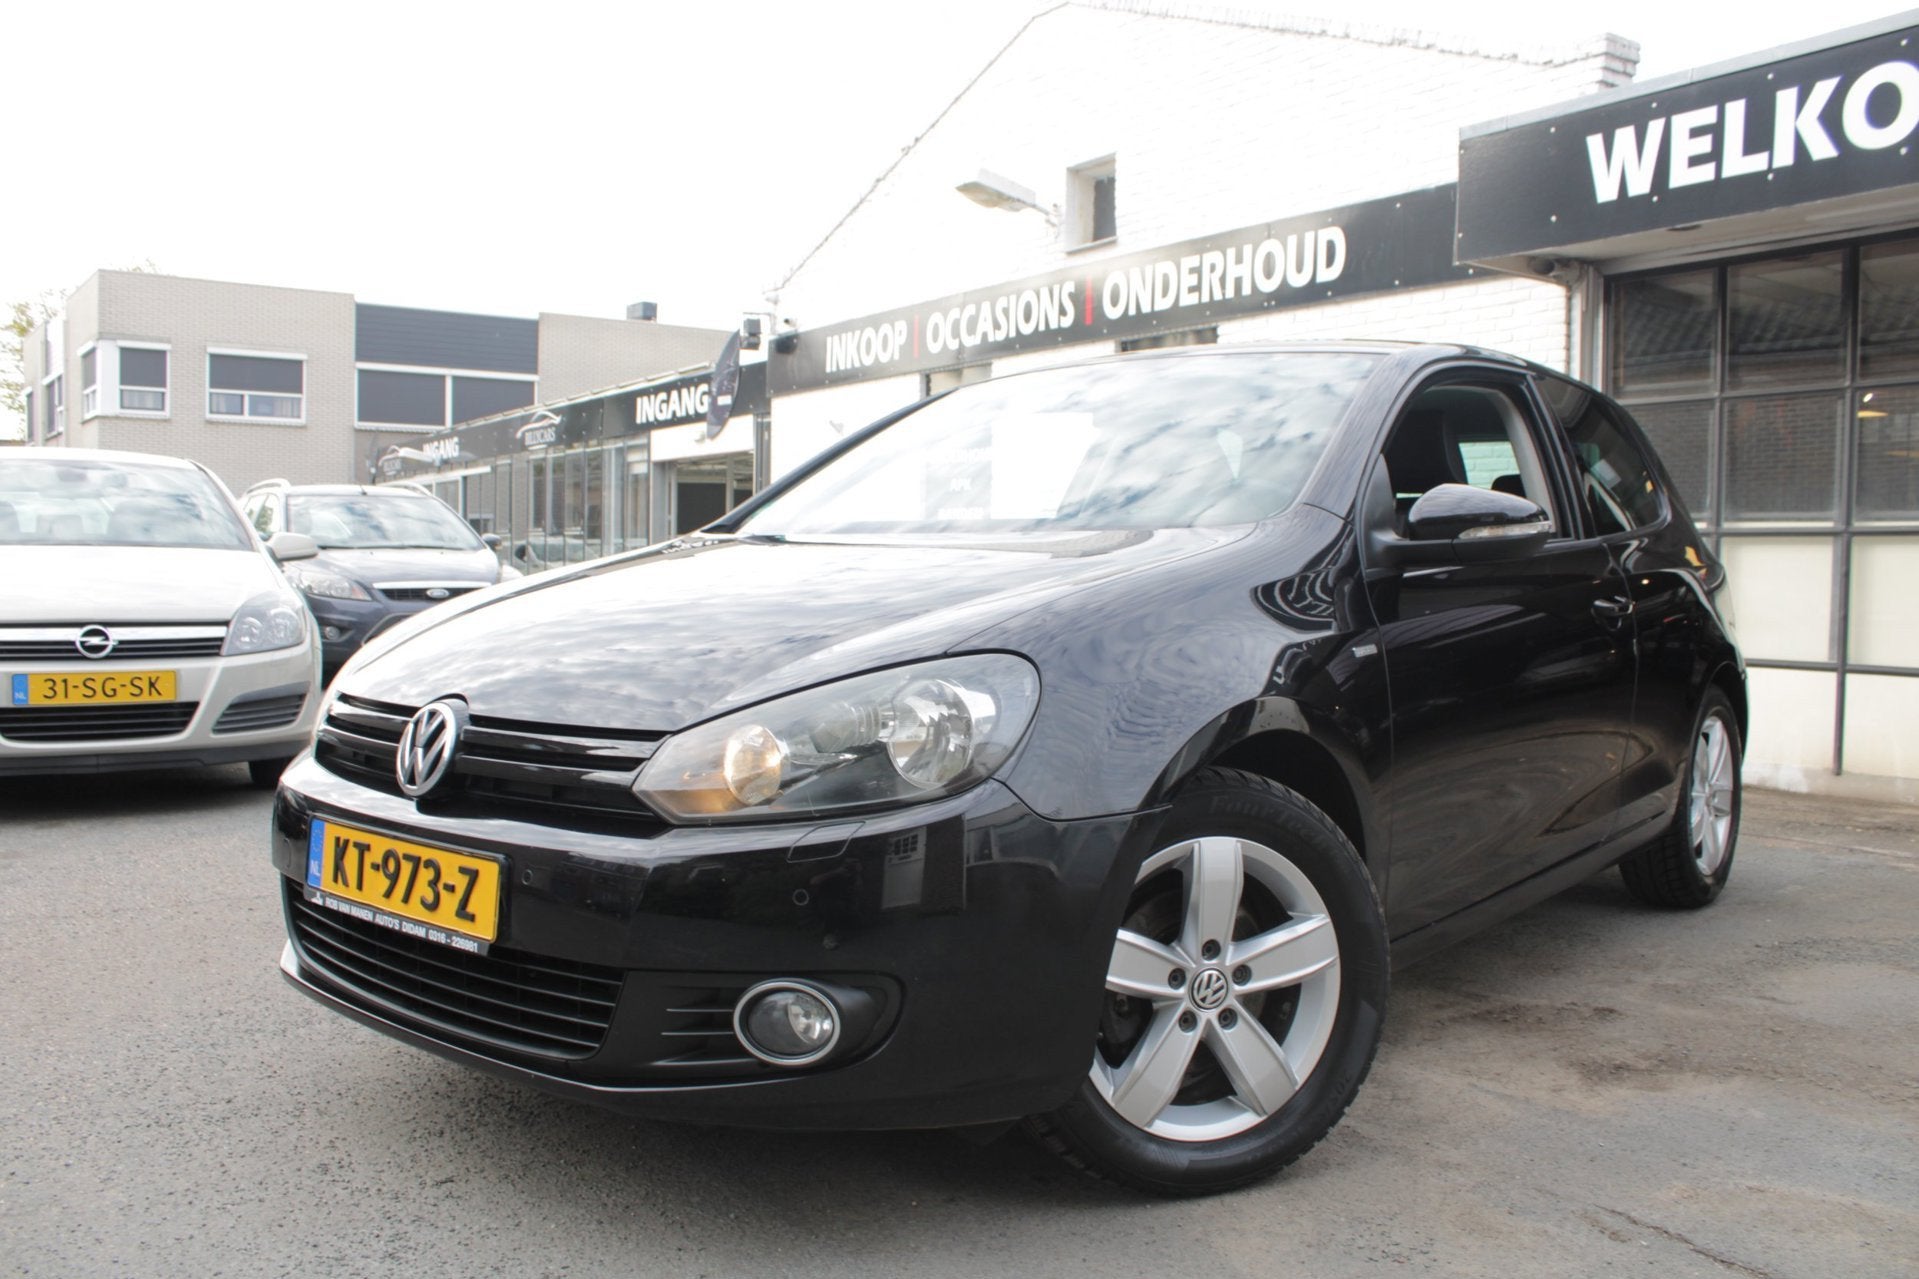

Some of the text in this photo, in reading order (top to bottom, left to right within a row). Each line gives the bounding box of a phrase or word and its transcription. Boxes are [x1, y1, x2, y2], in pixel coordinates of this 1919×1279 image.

[1585, 60, 1919, 204] WELKO
[825, 226, 1347, 374] INKOOP OCCASIONS ONDERHOUD
[635, 383, 709, 424] INGANG
[14, 691, 27, 700] NL
[42, 676, 163, 700] 31-SG-SK
[310, 859, 321, 877] NL
[331, 835, 479, 923] KT-973-Z
[374, 913, 400, 931] AUTO'S
[402, 921, 427, 939] DIDAM
